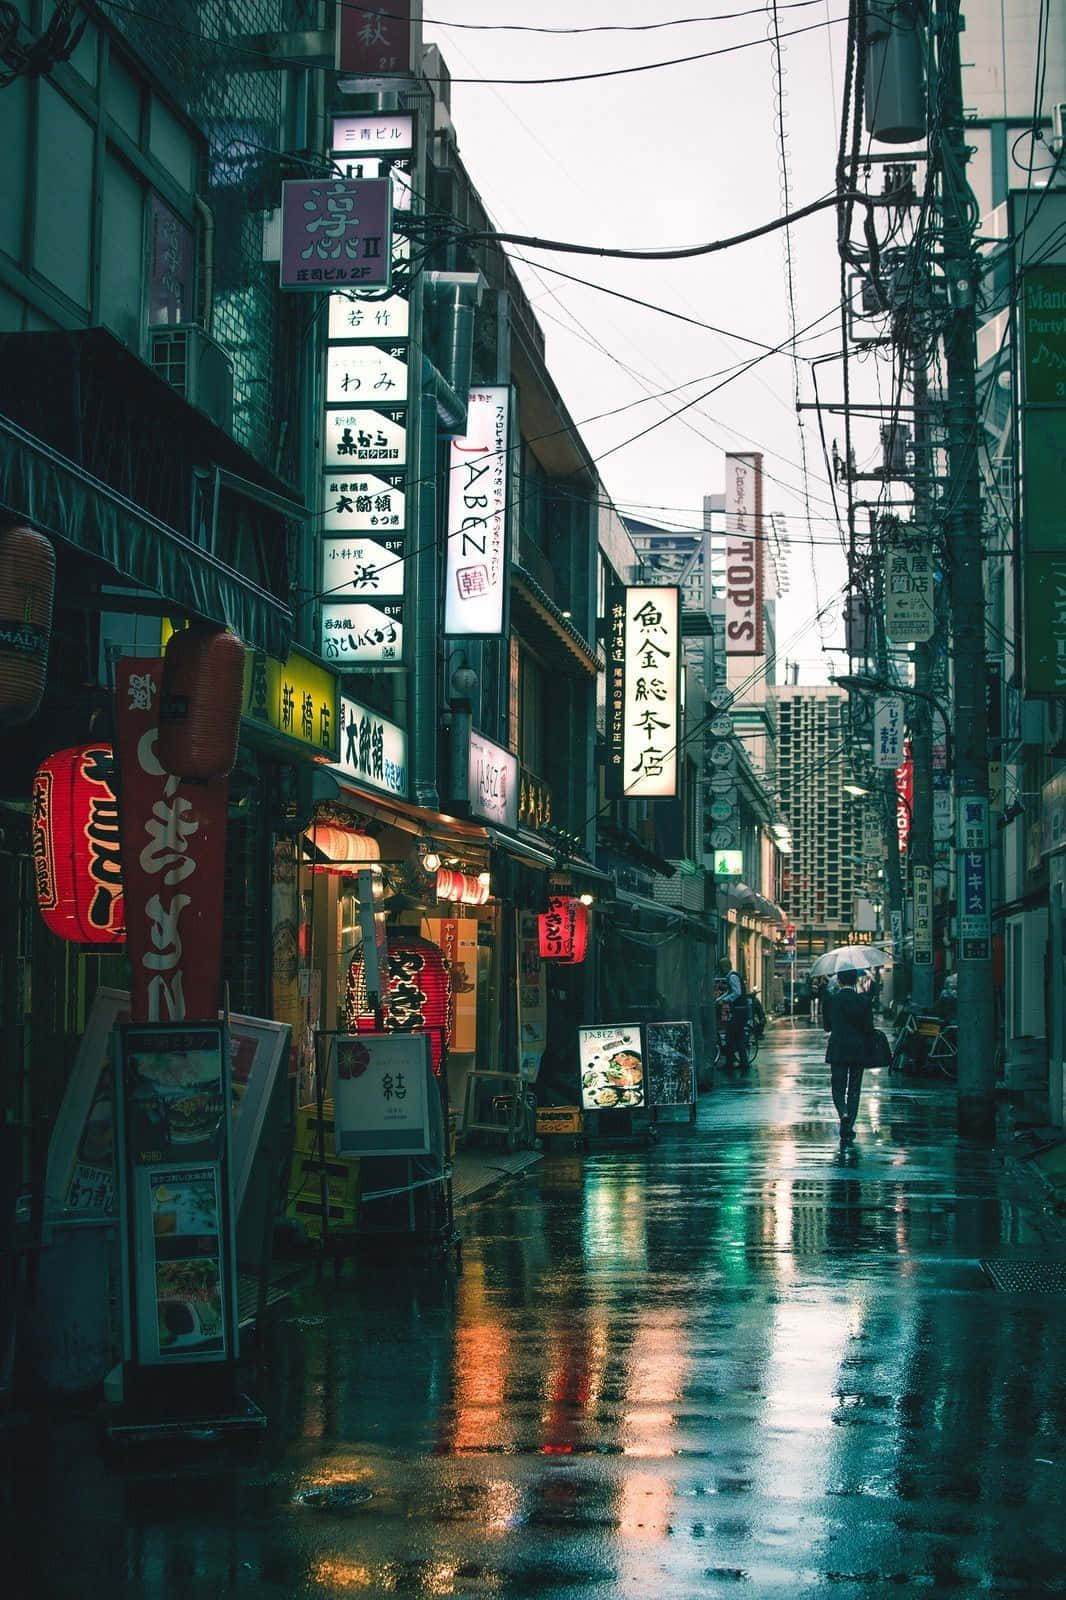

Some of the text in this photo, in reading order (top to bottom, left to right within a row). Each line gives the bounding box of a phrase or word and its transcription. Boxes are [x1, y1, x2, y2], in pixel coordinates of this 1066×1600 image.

[393, 160, 409, 169] 3F
[351, 267, 372, 279] 2F
[348, 309, 393, 327] 若竹
[391, 350, 406, 360] 2F
[391, 412, 405, 421] 1F
[390, 476, 403, 485] 1F
[386, 541, 403, 551] B1F
[328, 547, 365, 561] 小料理
[353, 563, 380, 589] 浜
[461, 570, 485, 596] 韓
[385, 606, 402, 615] B1F
[632, 600, 671, 778] 魚金総本店
